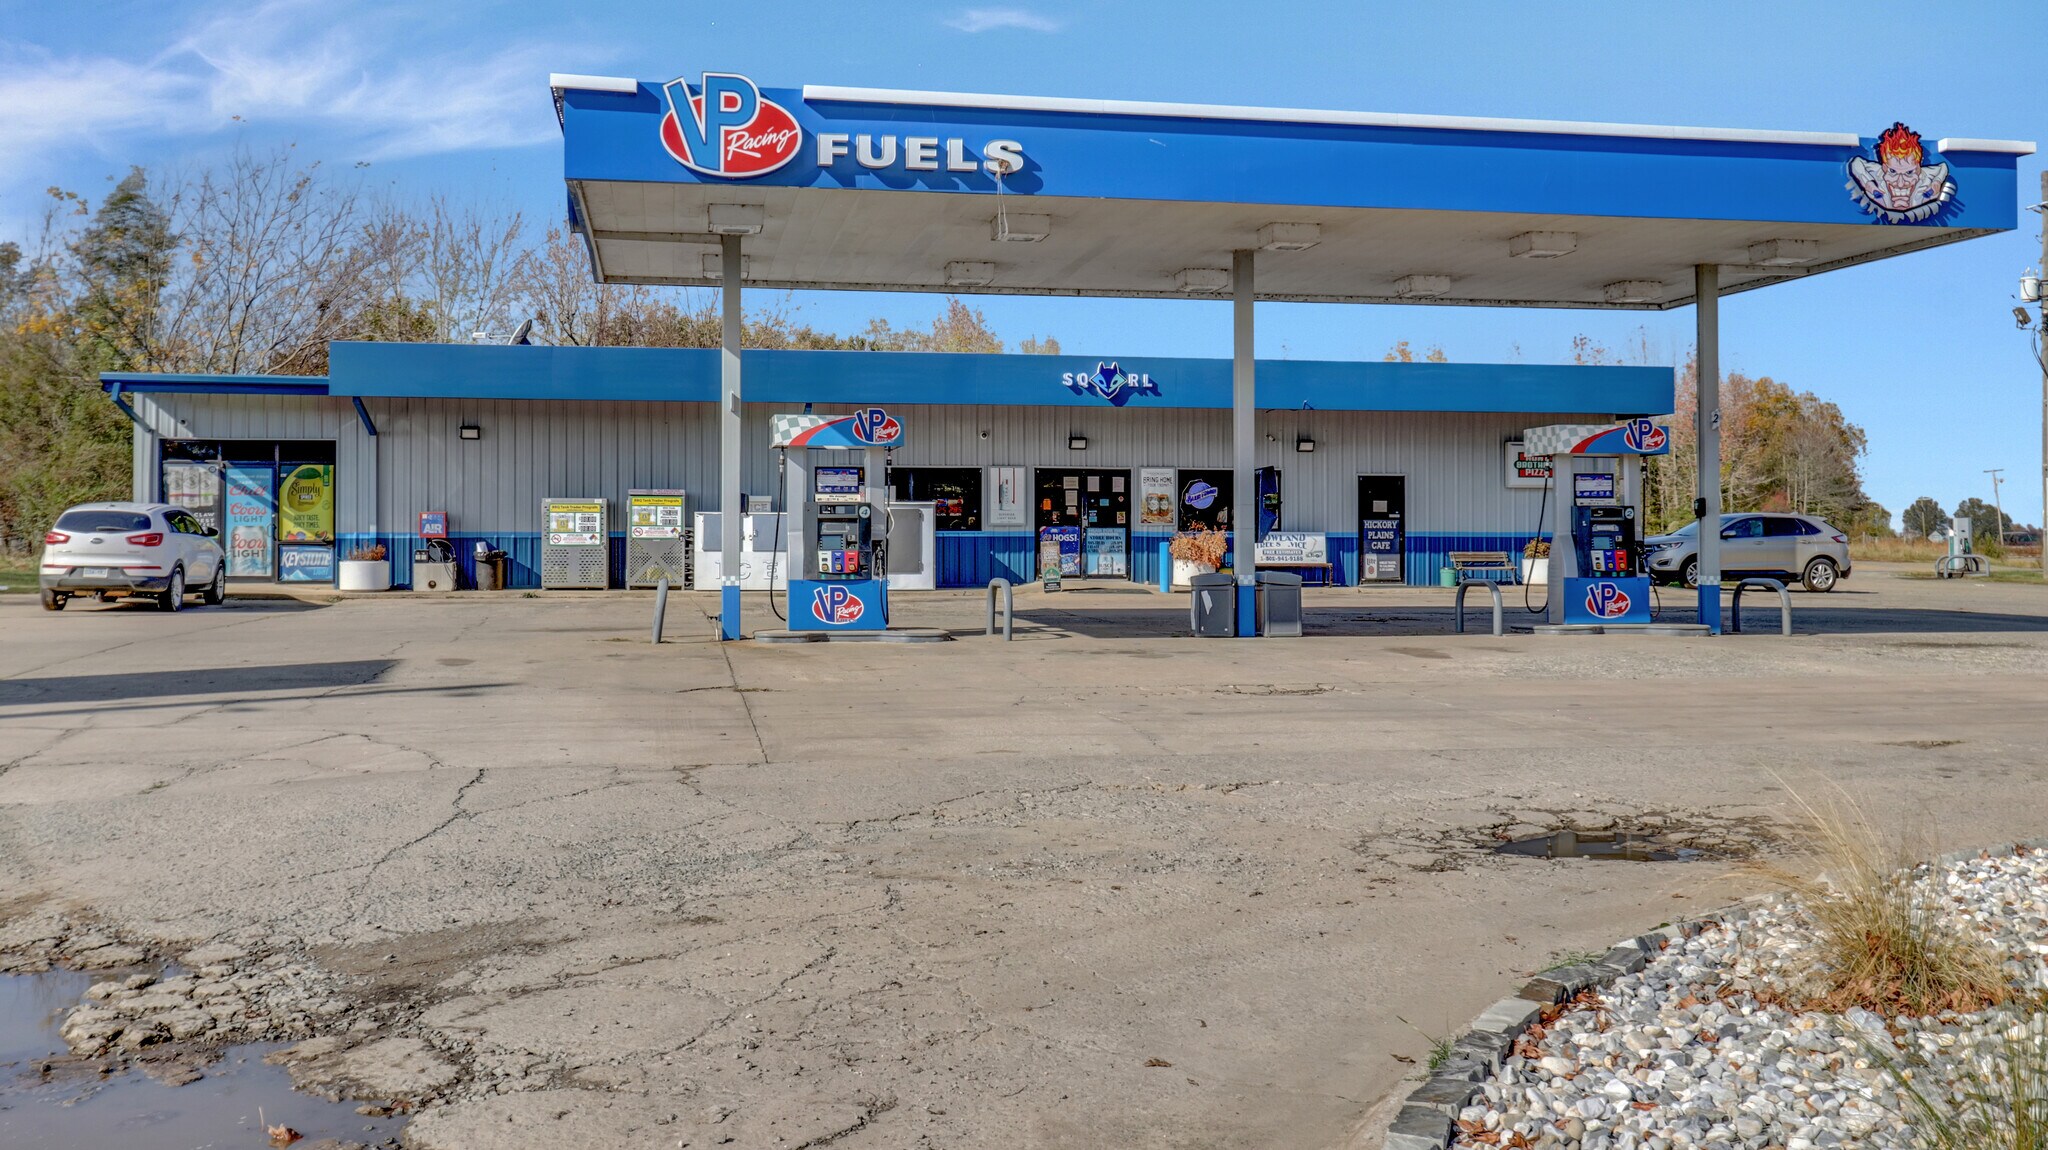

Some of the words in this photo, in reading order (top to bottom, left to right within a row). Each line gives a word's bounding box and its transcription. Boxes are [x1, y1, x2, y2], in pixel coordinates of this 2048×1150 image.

[663, 71, 761, 172] VP
[727, 126, 799, 160] Racing
[817, 133, 1024, 174] FUELS
[855, 408, 887, 443] VP
[1627, 419, 1654, 450] VP
[291, 482, 321, 496] Simply
[229, 502, 267, 515] Coors
[423, 523, 443, 534] AIR
[1363, 520, 1398, 529] HICKORY
[1367, 531, 1395, 539] PLAINS
[231, 533, 267, 549] Coor
[1371, 542, 1390, 550] CAFE
[814, 585, 850, 623] VP
[1587, 582, 1618, 617] VP
